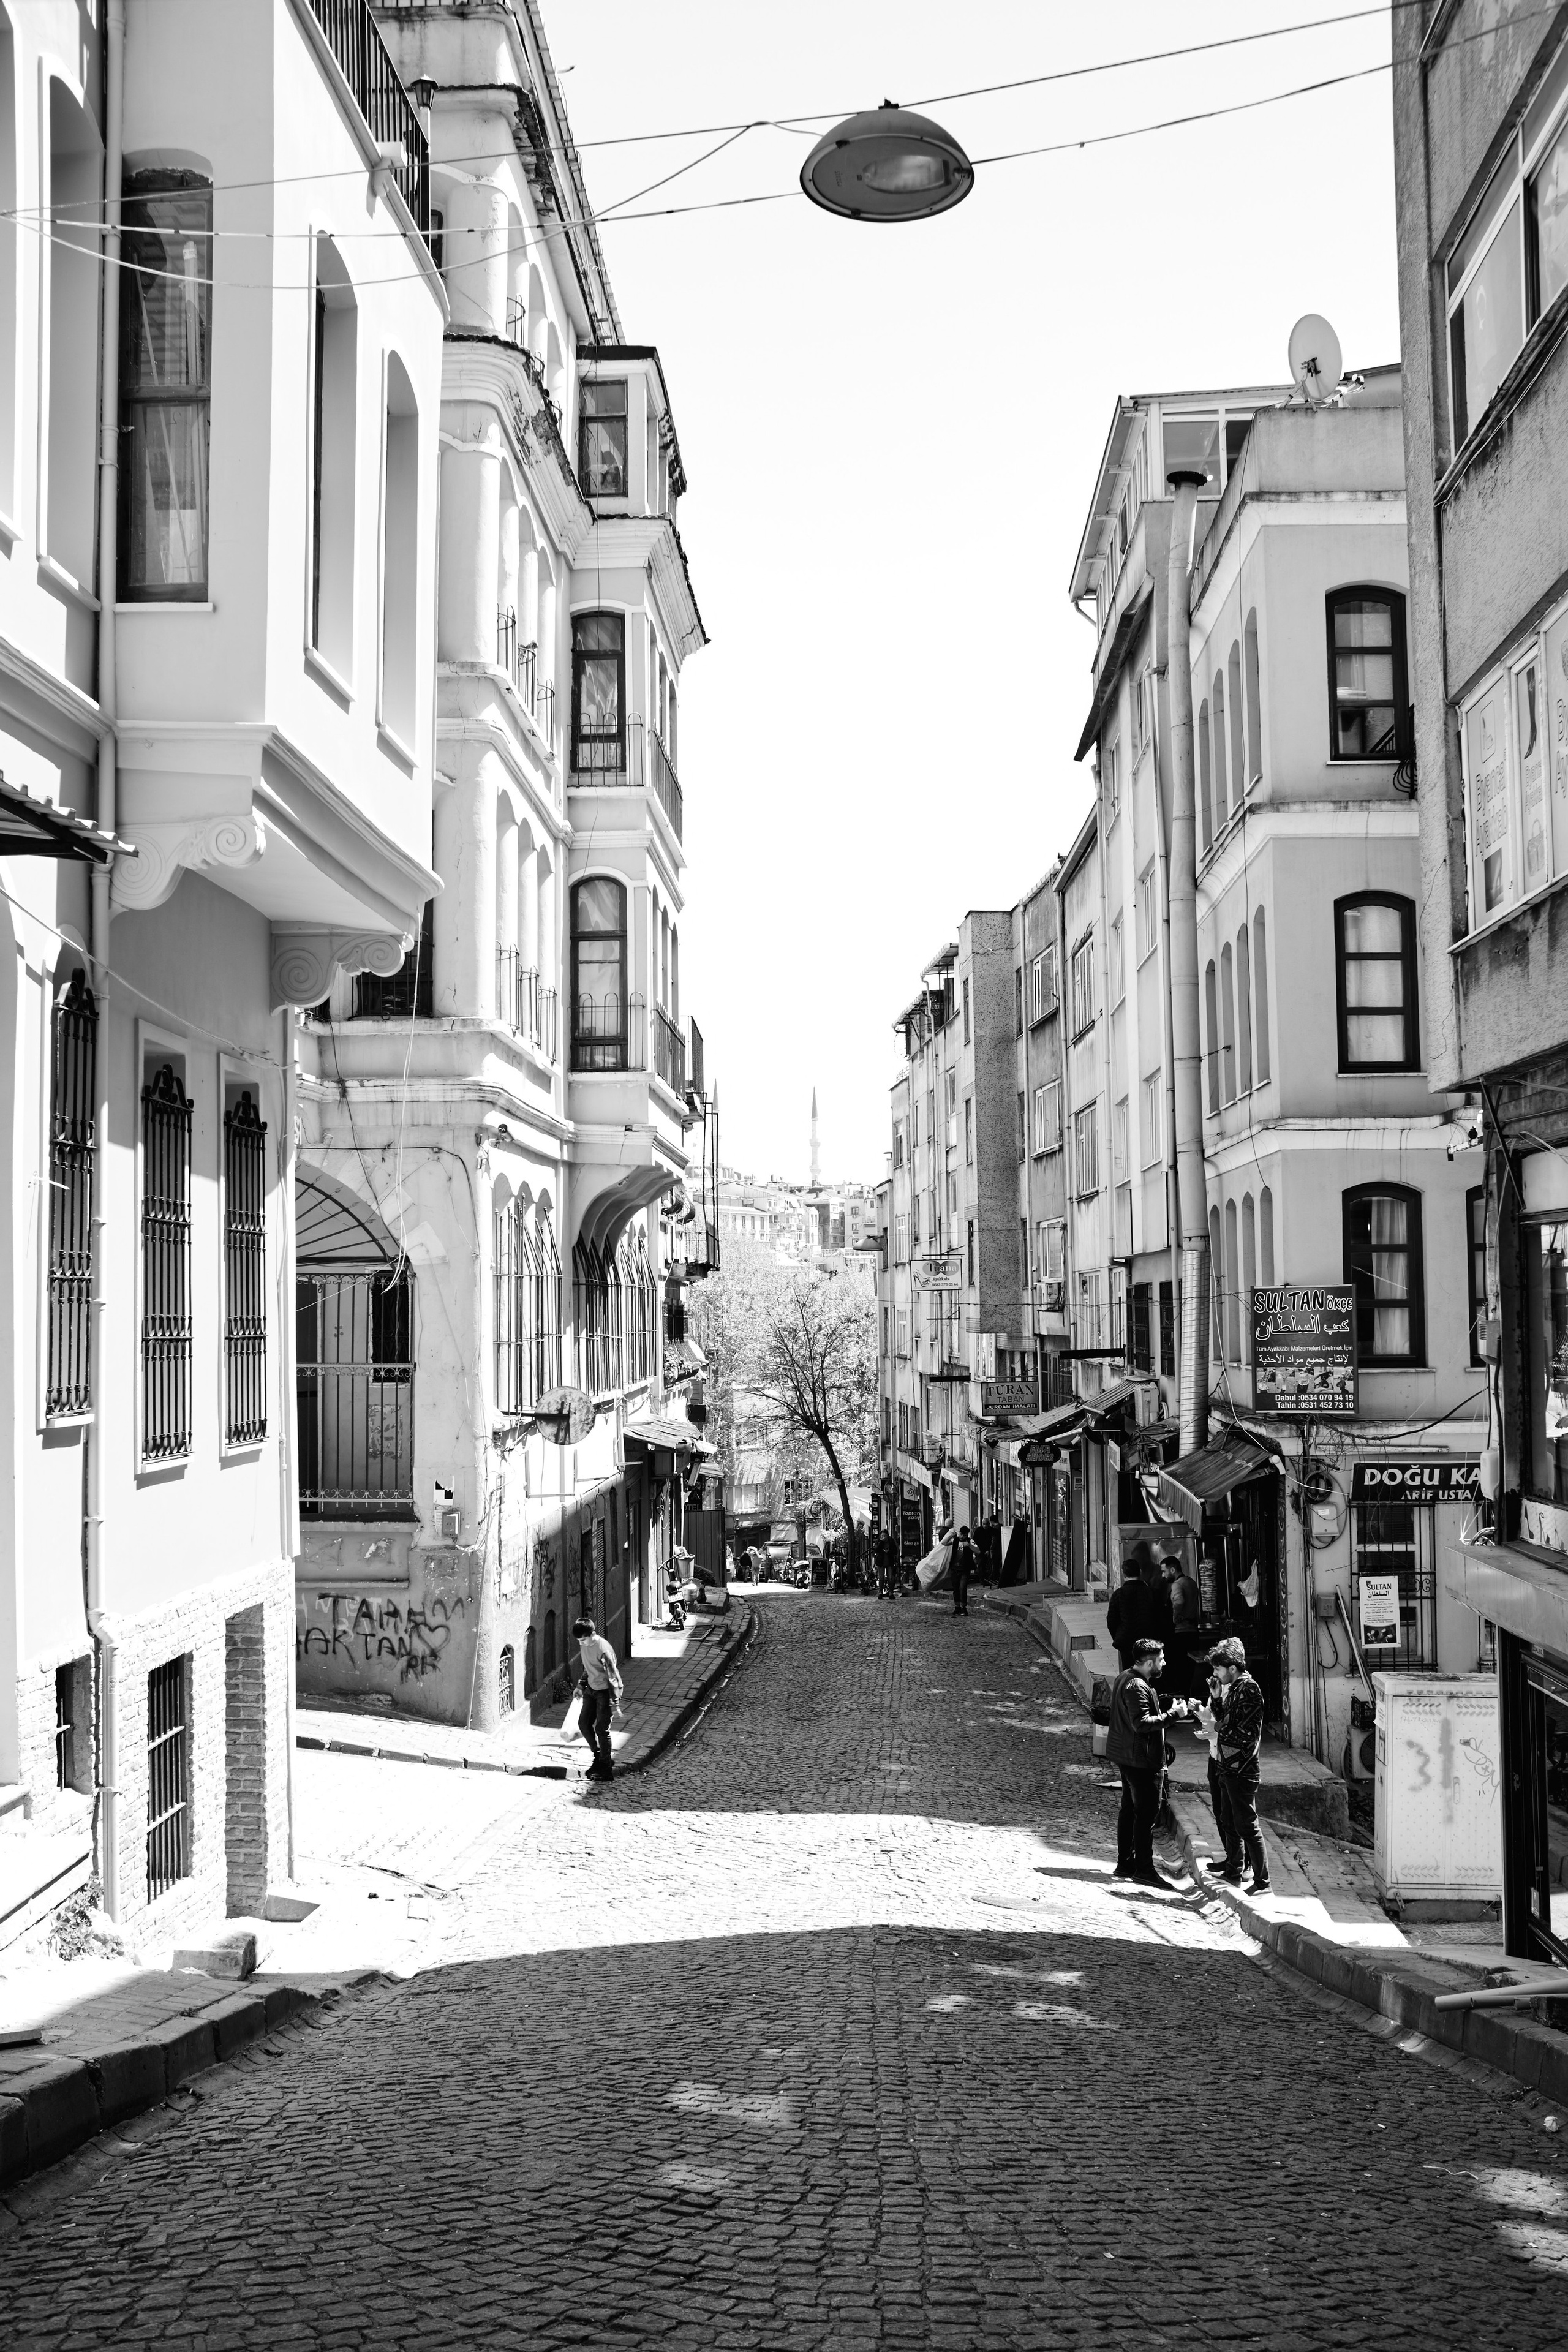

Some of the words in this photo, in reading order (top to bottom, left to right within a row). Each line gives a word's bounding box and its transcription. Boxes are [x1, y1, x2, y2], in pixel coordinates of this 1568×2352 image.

[927, 1263, 957, 1272] Tuana
[1254, 1290, 1325, 1313] SULTAN
[1327, 1295, 1353, 1313] ÖKÇE
[1256, 1314, 1321, 1340] السلطان
[1324, 1319, 1350, 1335] كعب
[1259, 1353, 1284, 1365] الأحذية
[1287, 1355, 1303, 1365] مواد
[1306, 1357, 1325, 1366] جميع
[986, 1384, 1035, 1396] TURAN
[1363, 1464, 1440, 1485] DOĞU
[1401, 1488, 1434, 1500] ARİF
[1439, 1490, 1472, 1499] USTA
